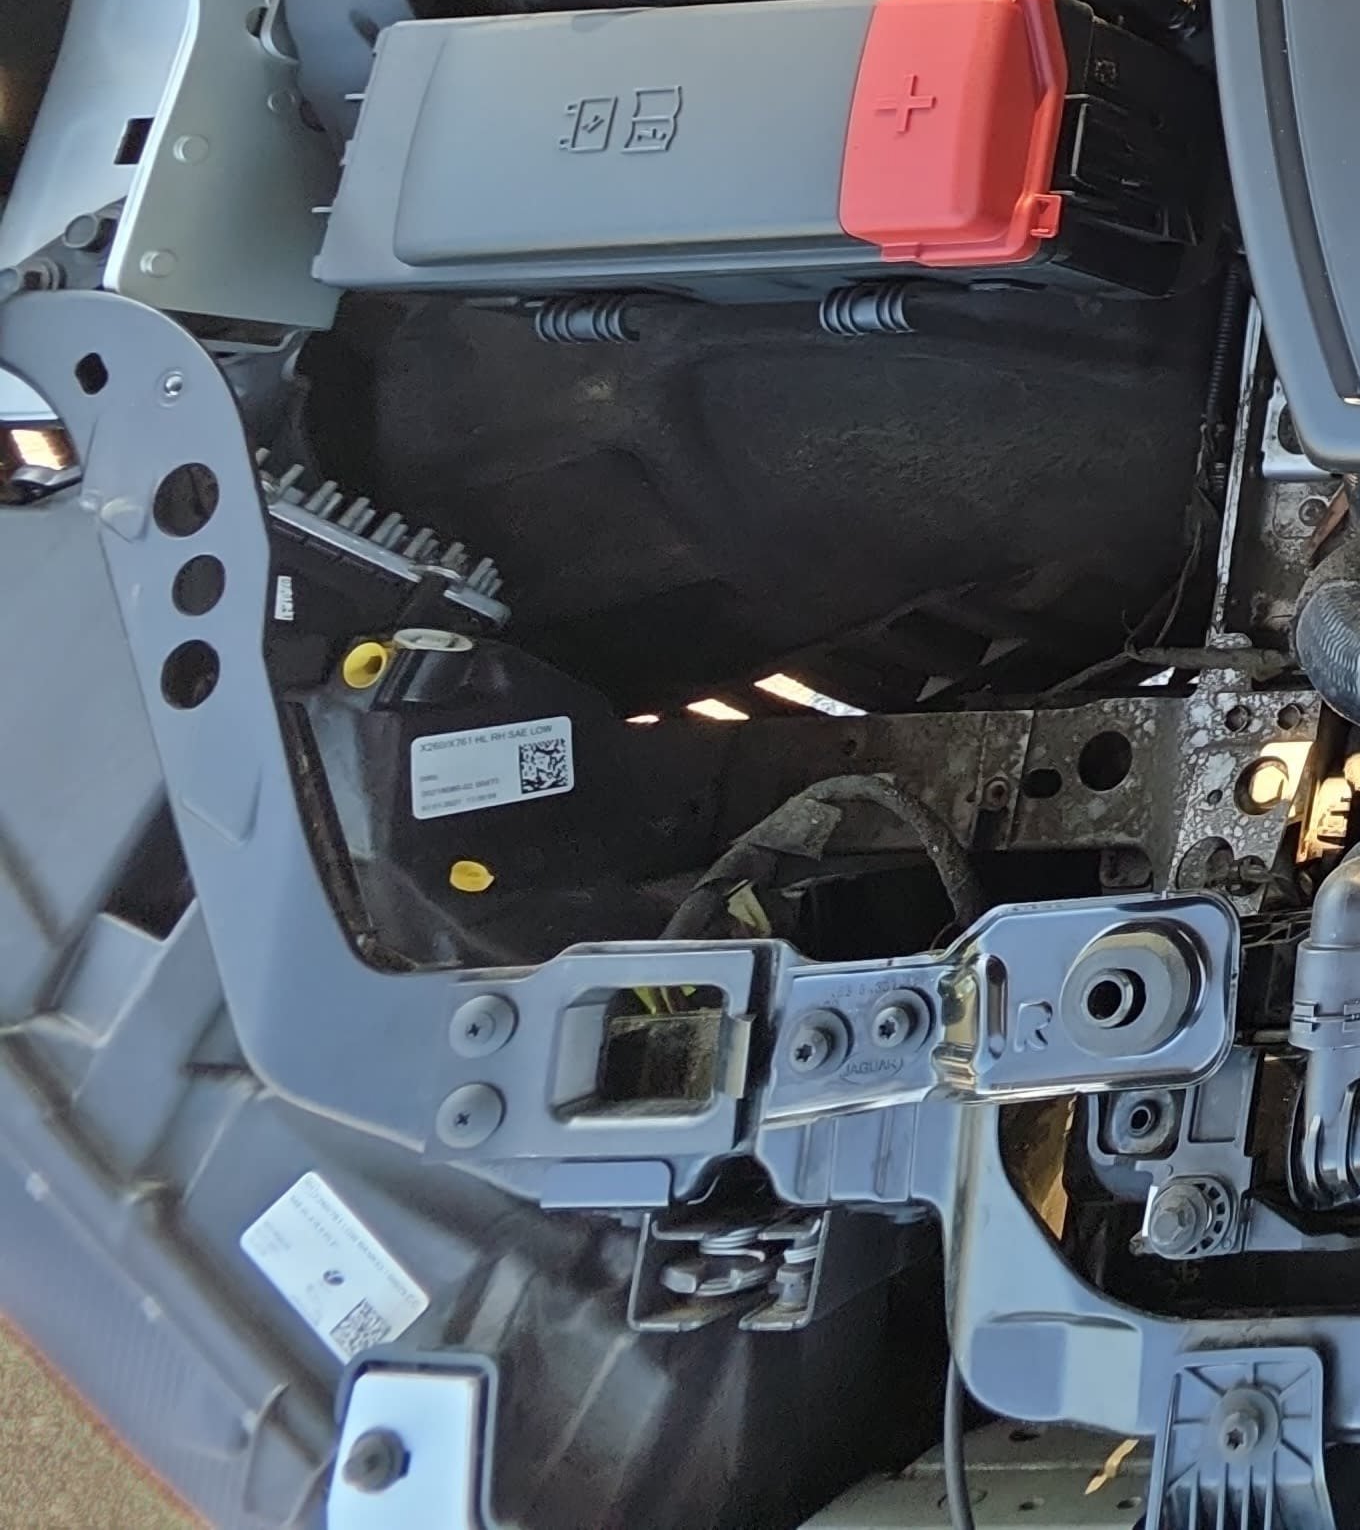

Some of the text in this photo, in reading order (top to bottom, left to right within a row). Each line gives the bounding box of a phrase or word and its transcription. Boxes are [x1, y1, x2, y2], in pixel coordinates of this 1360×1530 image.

[490, 731, 506, 742] RH
[507, 727, 528, 740] SAE
[529, 724, 553, 737] LOW
[1014, 1000, 1054, 1053] R
